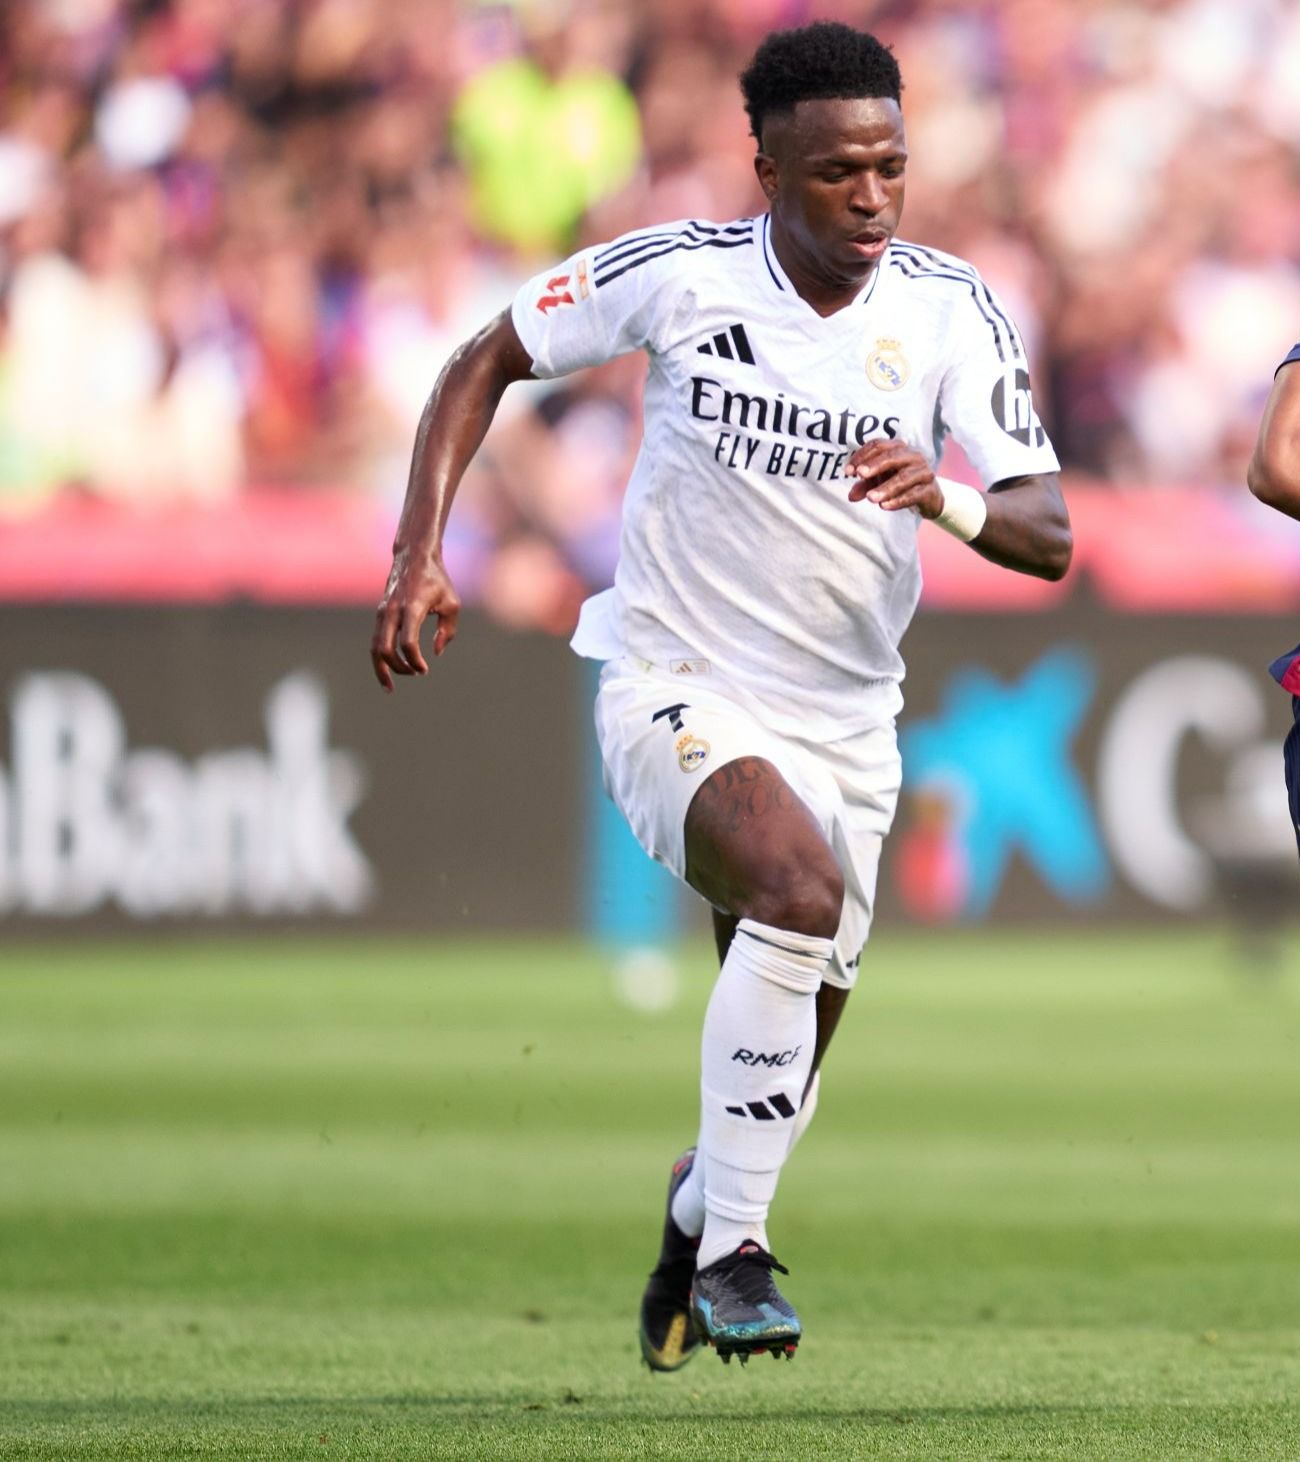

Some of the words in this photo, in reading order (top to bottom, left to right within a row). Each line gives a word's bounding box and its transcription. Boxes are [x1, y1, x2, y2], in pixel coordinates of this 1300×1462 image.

[690, 376, 901, 446] Emirates
[715, 432, 761, 470] FLY
[766, 442, 858, 481] BETTE
[0, 668, 380, 916] Bank
